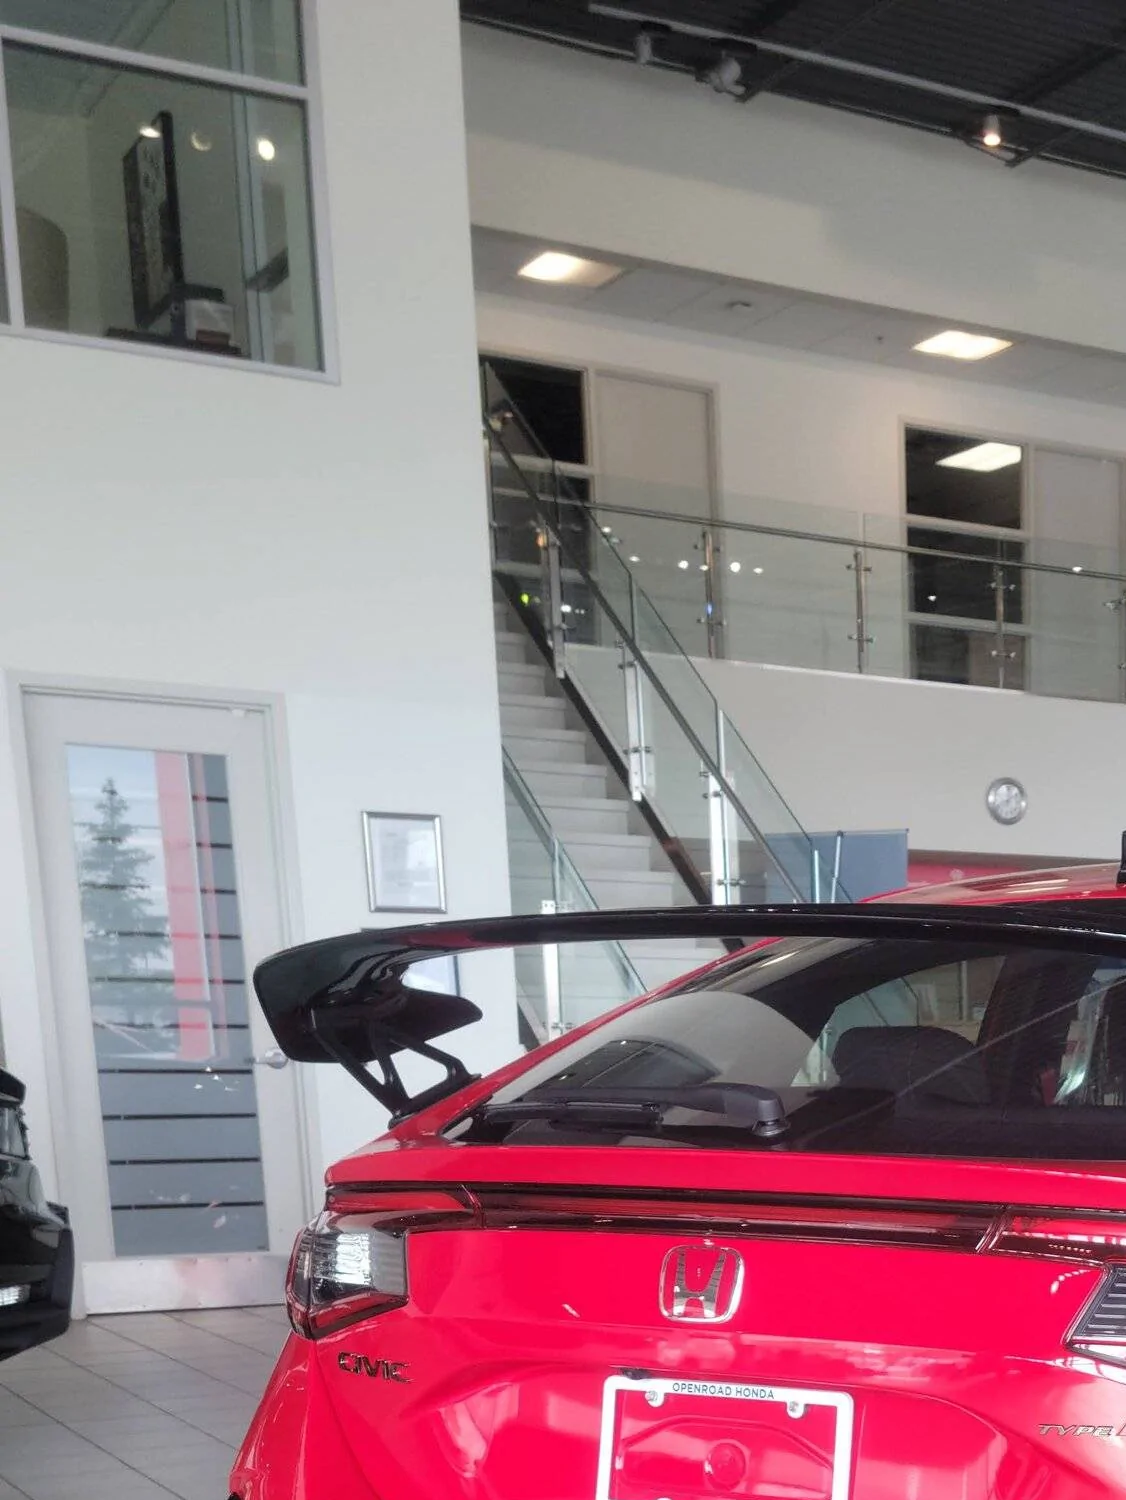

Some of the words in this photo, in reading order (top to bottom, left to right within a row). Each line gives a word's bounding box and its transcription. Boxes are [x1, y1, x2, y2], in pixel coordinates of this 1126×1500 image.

[338, 1352, 414, 1383] CIVIC
[672, 1382, 733, 1397] OPENROAD
[735, 1386, 775, 1400] HONDA
[1038, 1423, 1115, 1437] TYPE
